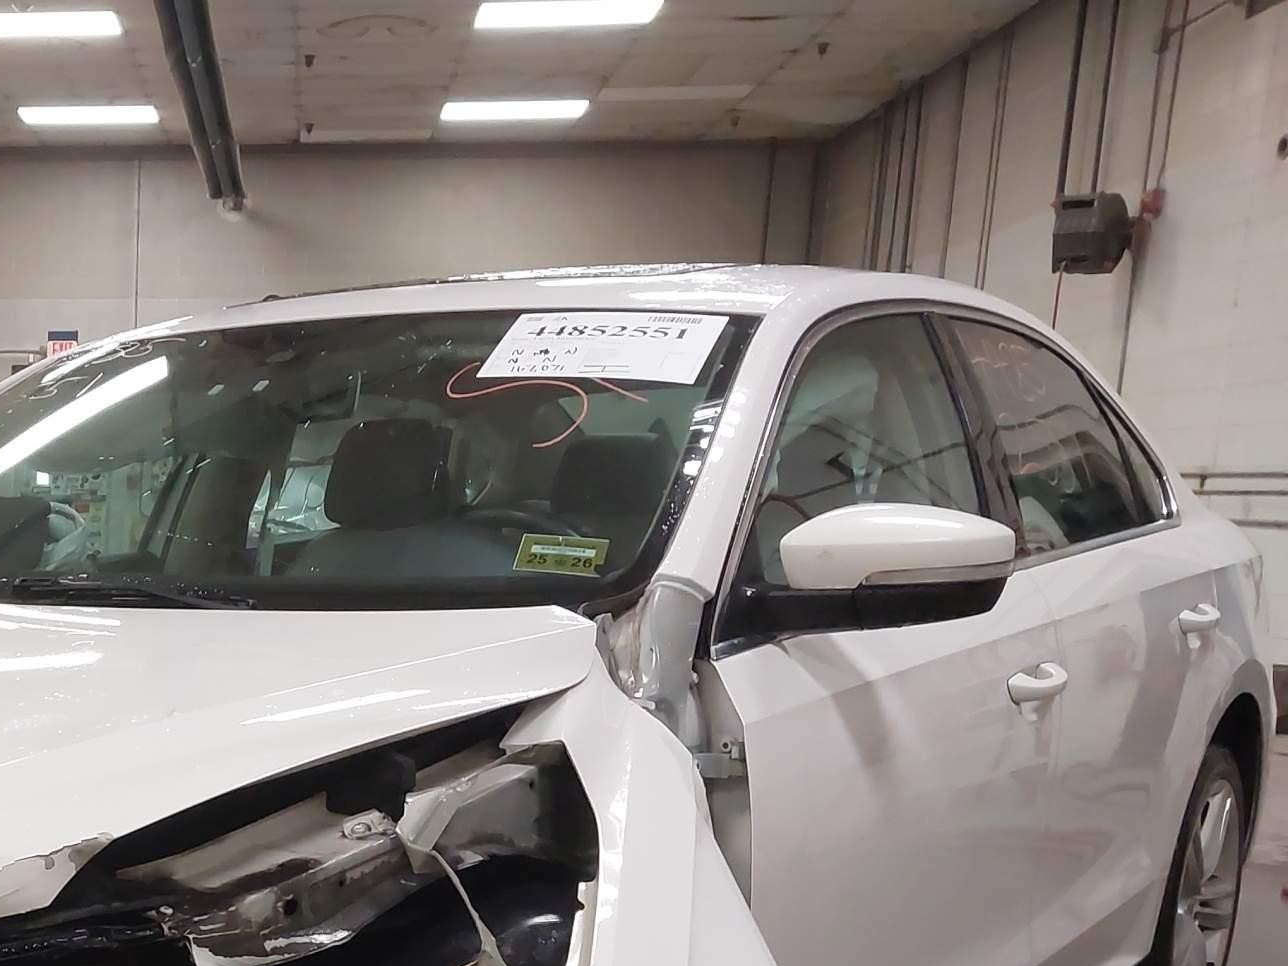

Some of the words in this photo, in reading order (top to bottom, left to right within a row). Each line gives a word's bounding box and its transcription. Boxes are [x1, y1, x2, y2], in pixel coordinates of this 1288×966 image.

[527, 324, 689, 340] 44852551
[526, 553, 548, 565] 25
[570, 557, 593, 569] 26
